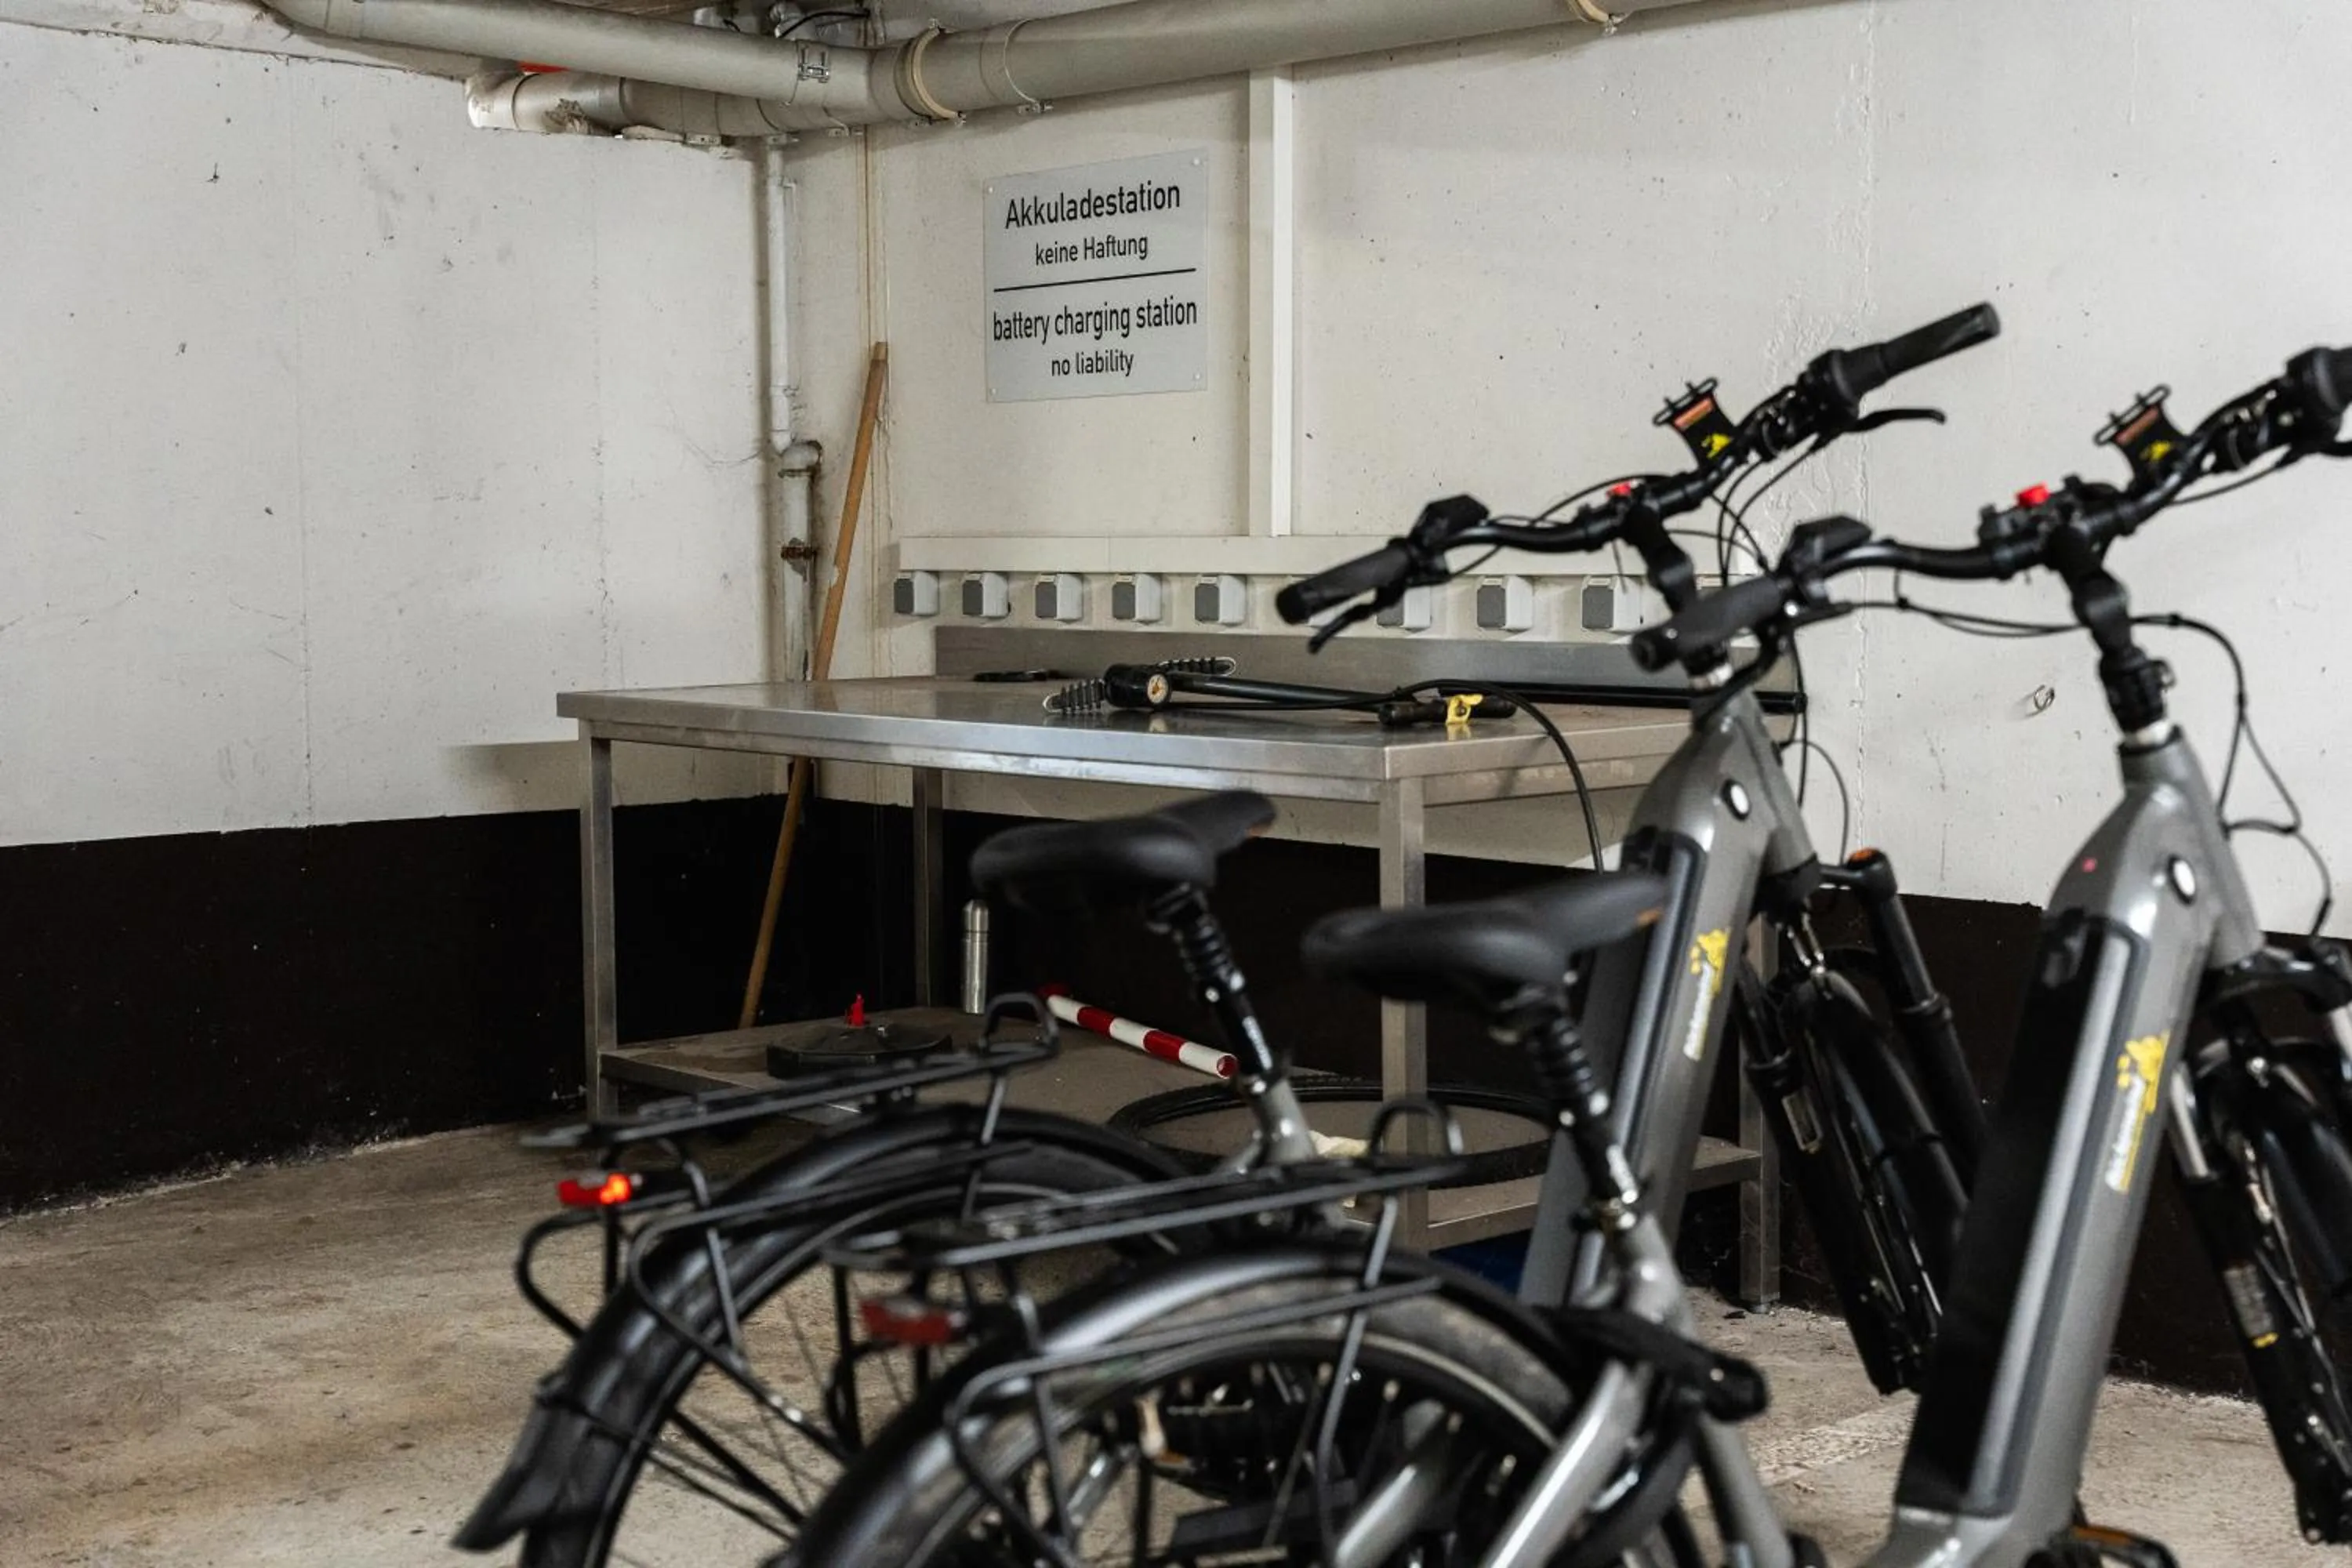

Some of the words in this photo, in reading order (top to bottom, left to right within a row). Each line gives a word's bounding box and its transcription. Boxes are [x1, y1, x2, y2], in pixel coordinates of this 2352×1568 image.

[1004, 180, 1181, 230] Akkuladestation
[1035, 240, 1079, 267] keine
[1083, 234, 1149, 261] Haftung
[993, 310, 1051, 346] battery
[1054, 301, 1131, 341] charging
[1136, 294, 1197, 329] station
[1051, 358, 1071, 377] no
[1075, 349, 1134, 377] liability
